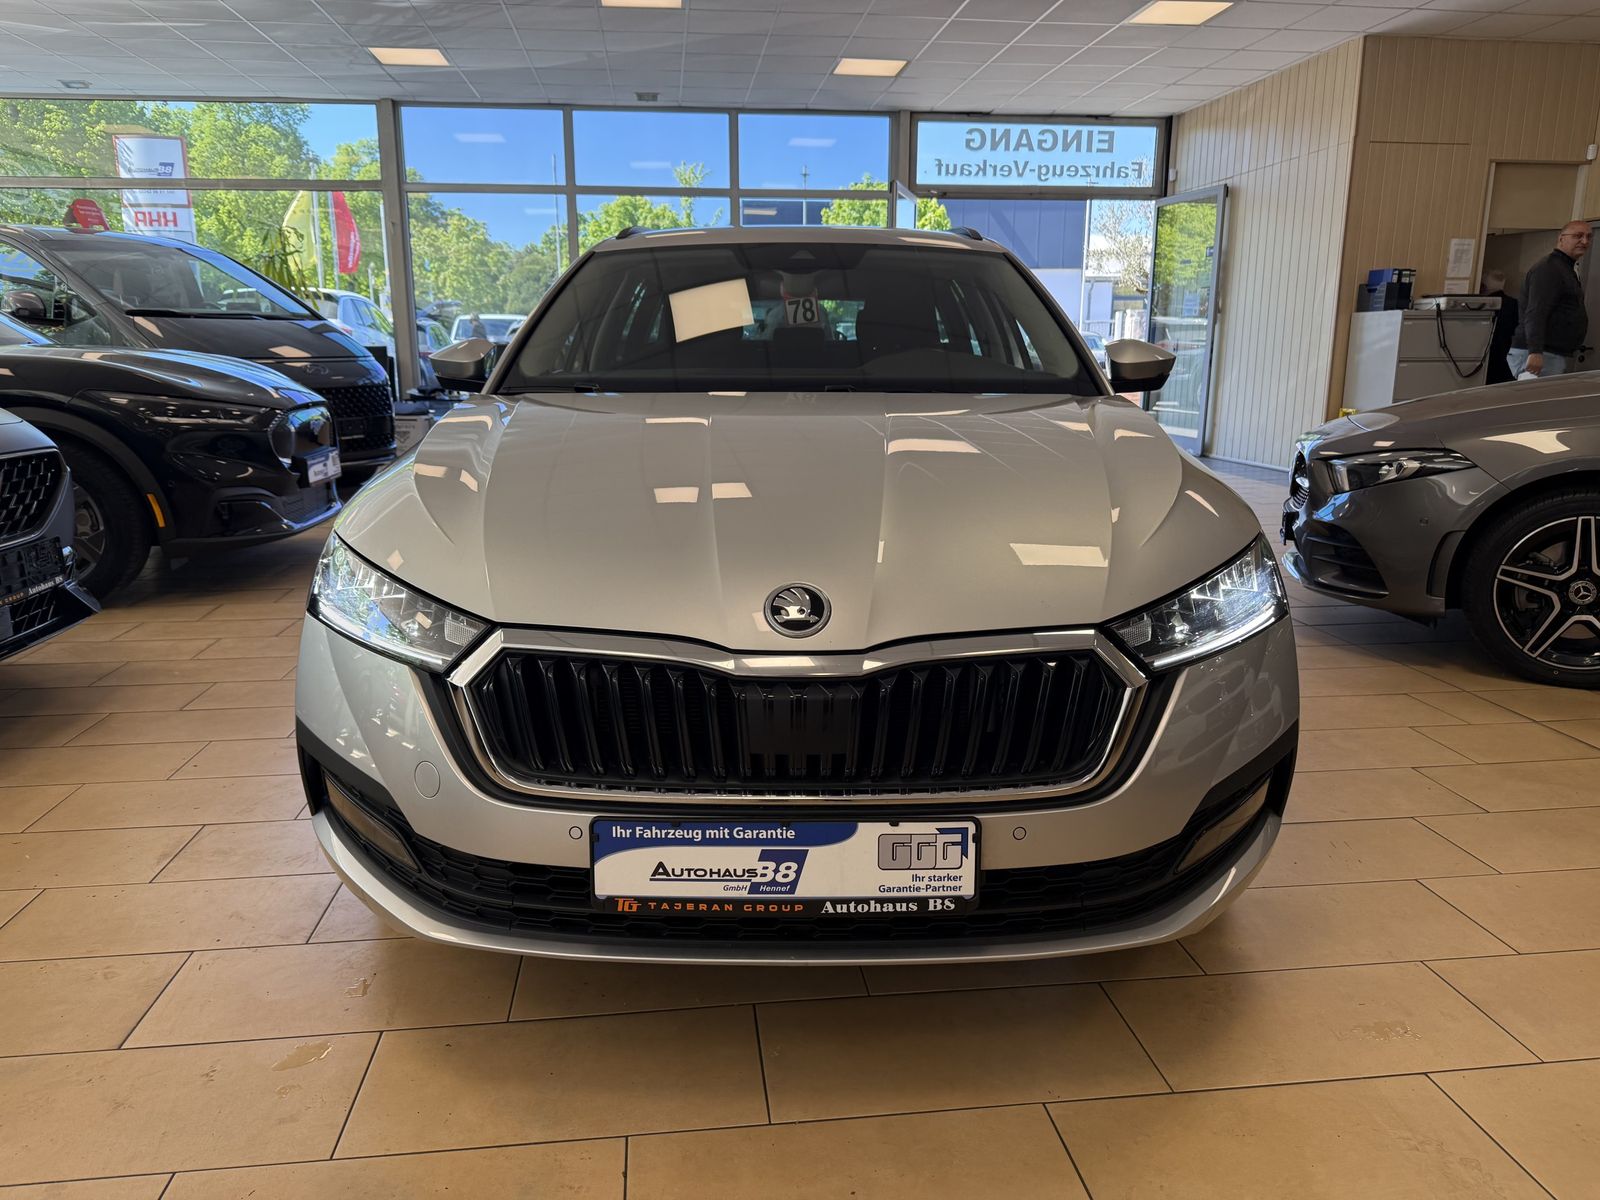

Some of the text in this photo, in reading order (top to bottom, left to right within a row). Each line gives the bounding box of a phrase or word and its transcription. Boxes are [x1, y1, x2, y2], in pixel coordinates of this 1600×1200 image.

[788, 299, 815, 323] 78
[612, 826, 796, 842] Ihr Fahrzeug mit Garantie
[650, 861, 799, 883] AUTOHAUS B8
[911, 873, 963, 882] Ihr starker
[723, 884, 791, 892] GmbH Hennef
[878, 884, 963, 893] Garantie-Partner
[649, 902, 733, 911] TAJERAN
[744, 904, 804, 912] GROUP
[821, 900, 918, 914] Autohaus
[928, 898, 956, 911] B8
